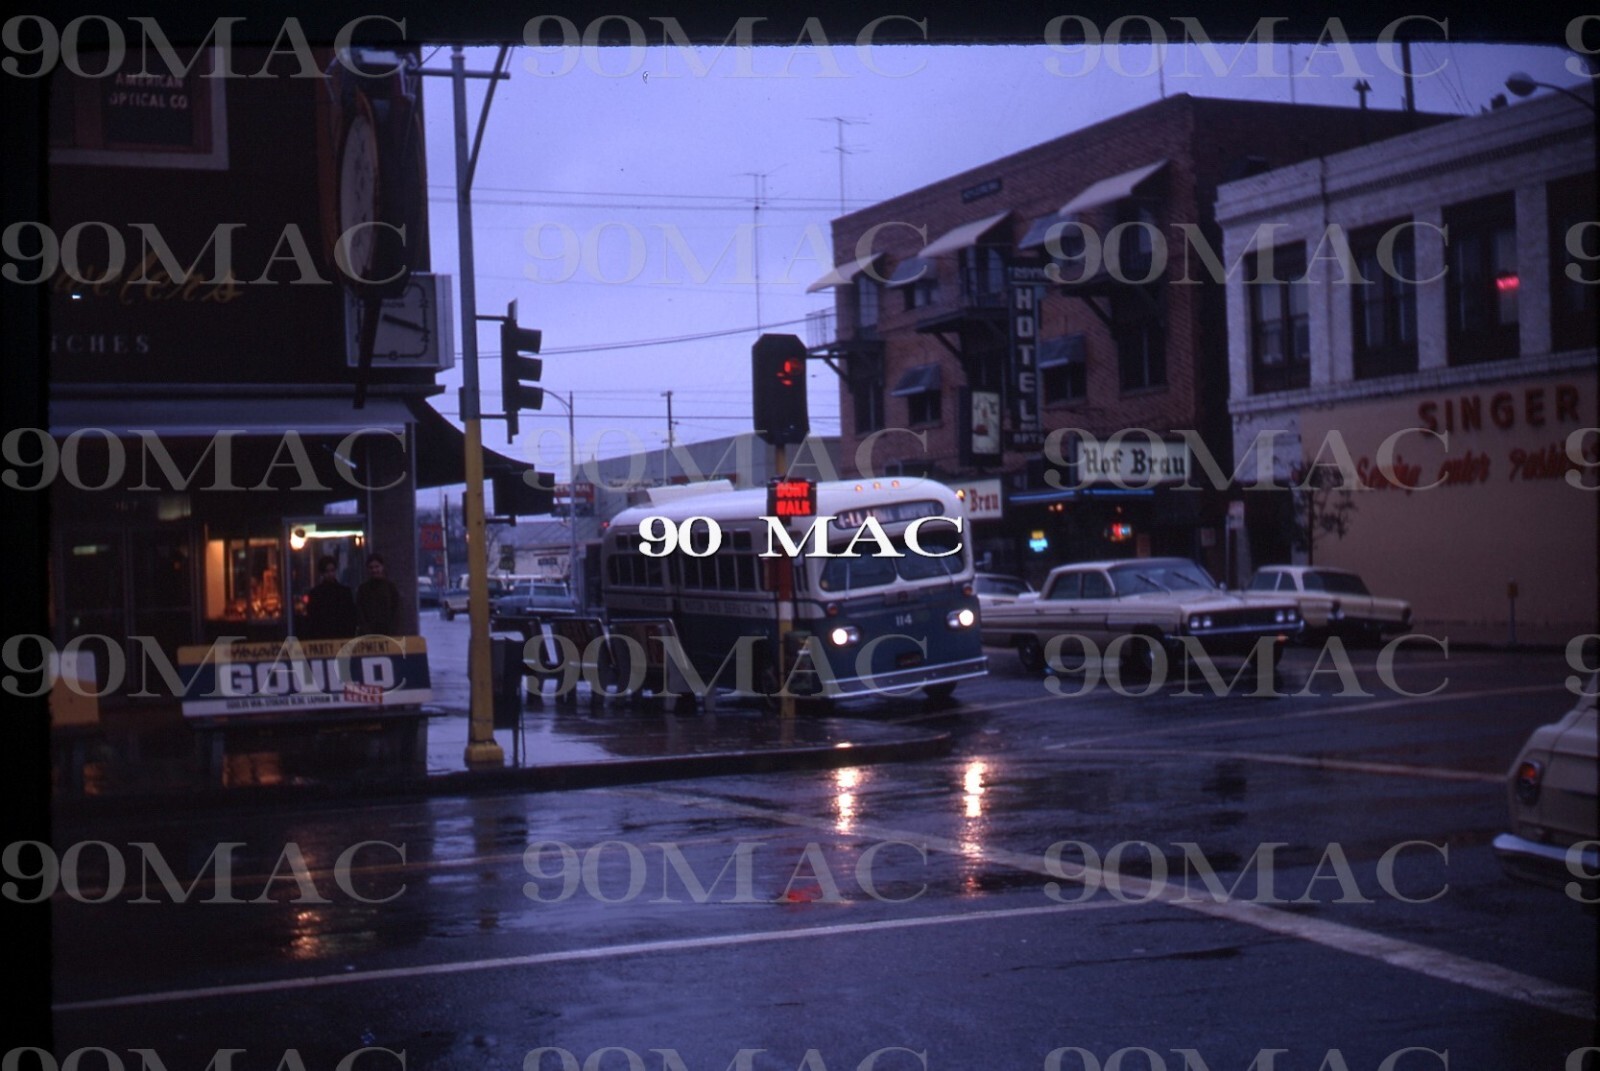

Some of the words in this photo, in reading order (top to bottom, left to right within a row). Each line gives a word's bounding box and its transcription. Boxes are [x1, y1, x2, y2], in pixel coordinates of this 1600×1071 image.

[115, 73, 184, 88] AMERICAN
[110, 92, 165, 107] OPTICAL
[169, 95, 188, 109] CO
[1014, 287, 1037, 422] HOTEL
[1418, 384, 1580, 437] SINGER
[1083, 446, 1123, 475] Hof
[1130, 450, 1186, 477] Brau
[776, 499, 811, 516] WALK
[970, 489, 999, 513] Brau
[896, 613, 912, 626] 114
[219, 656, 395, 697] GOULD
